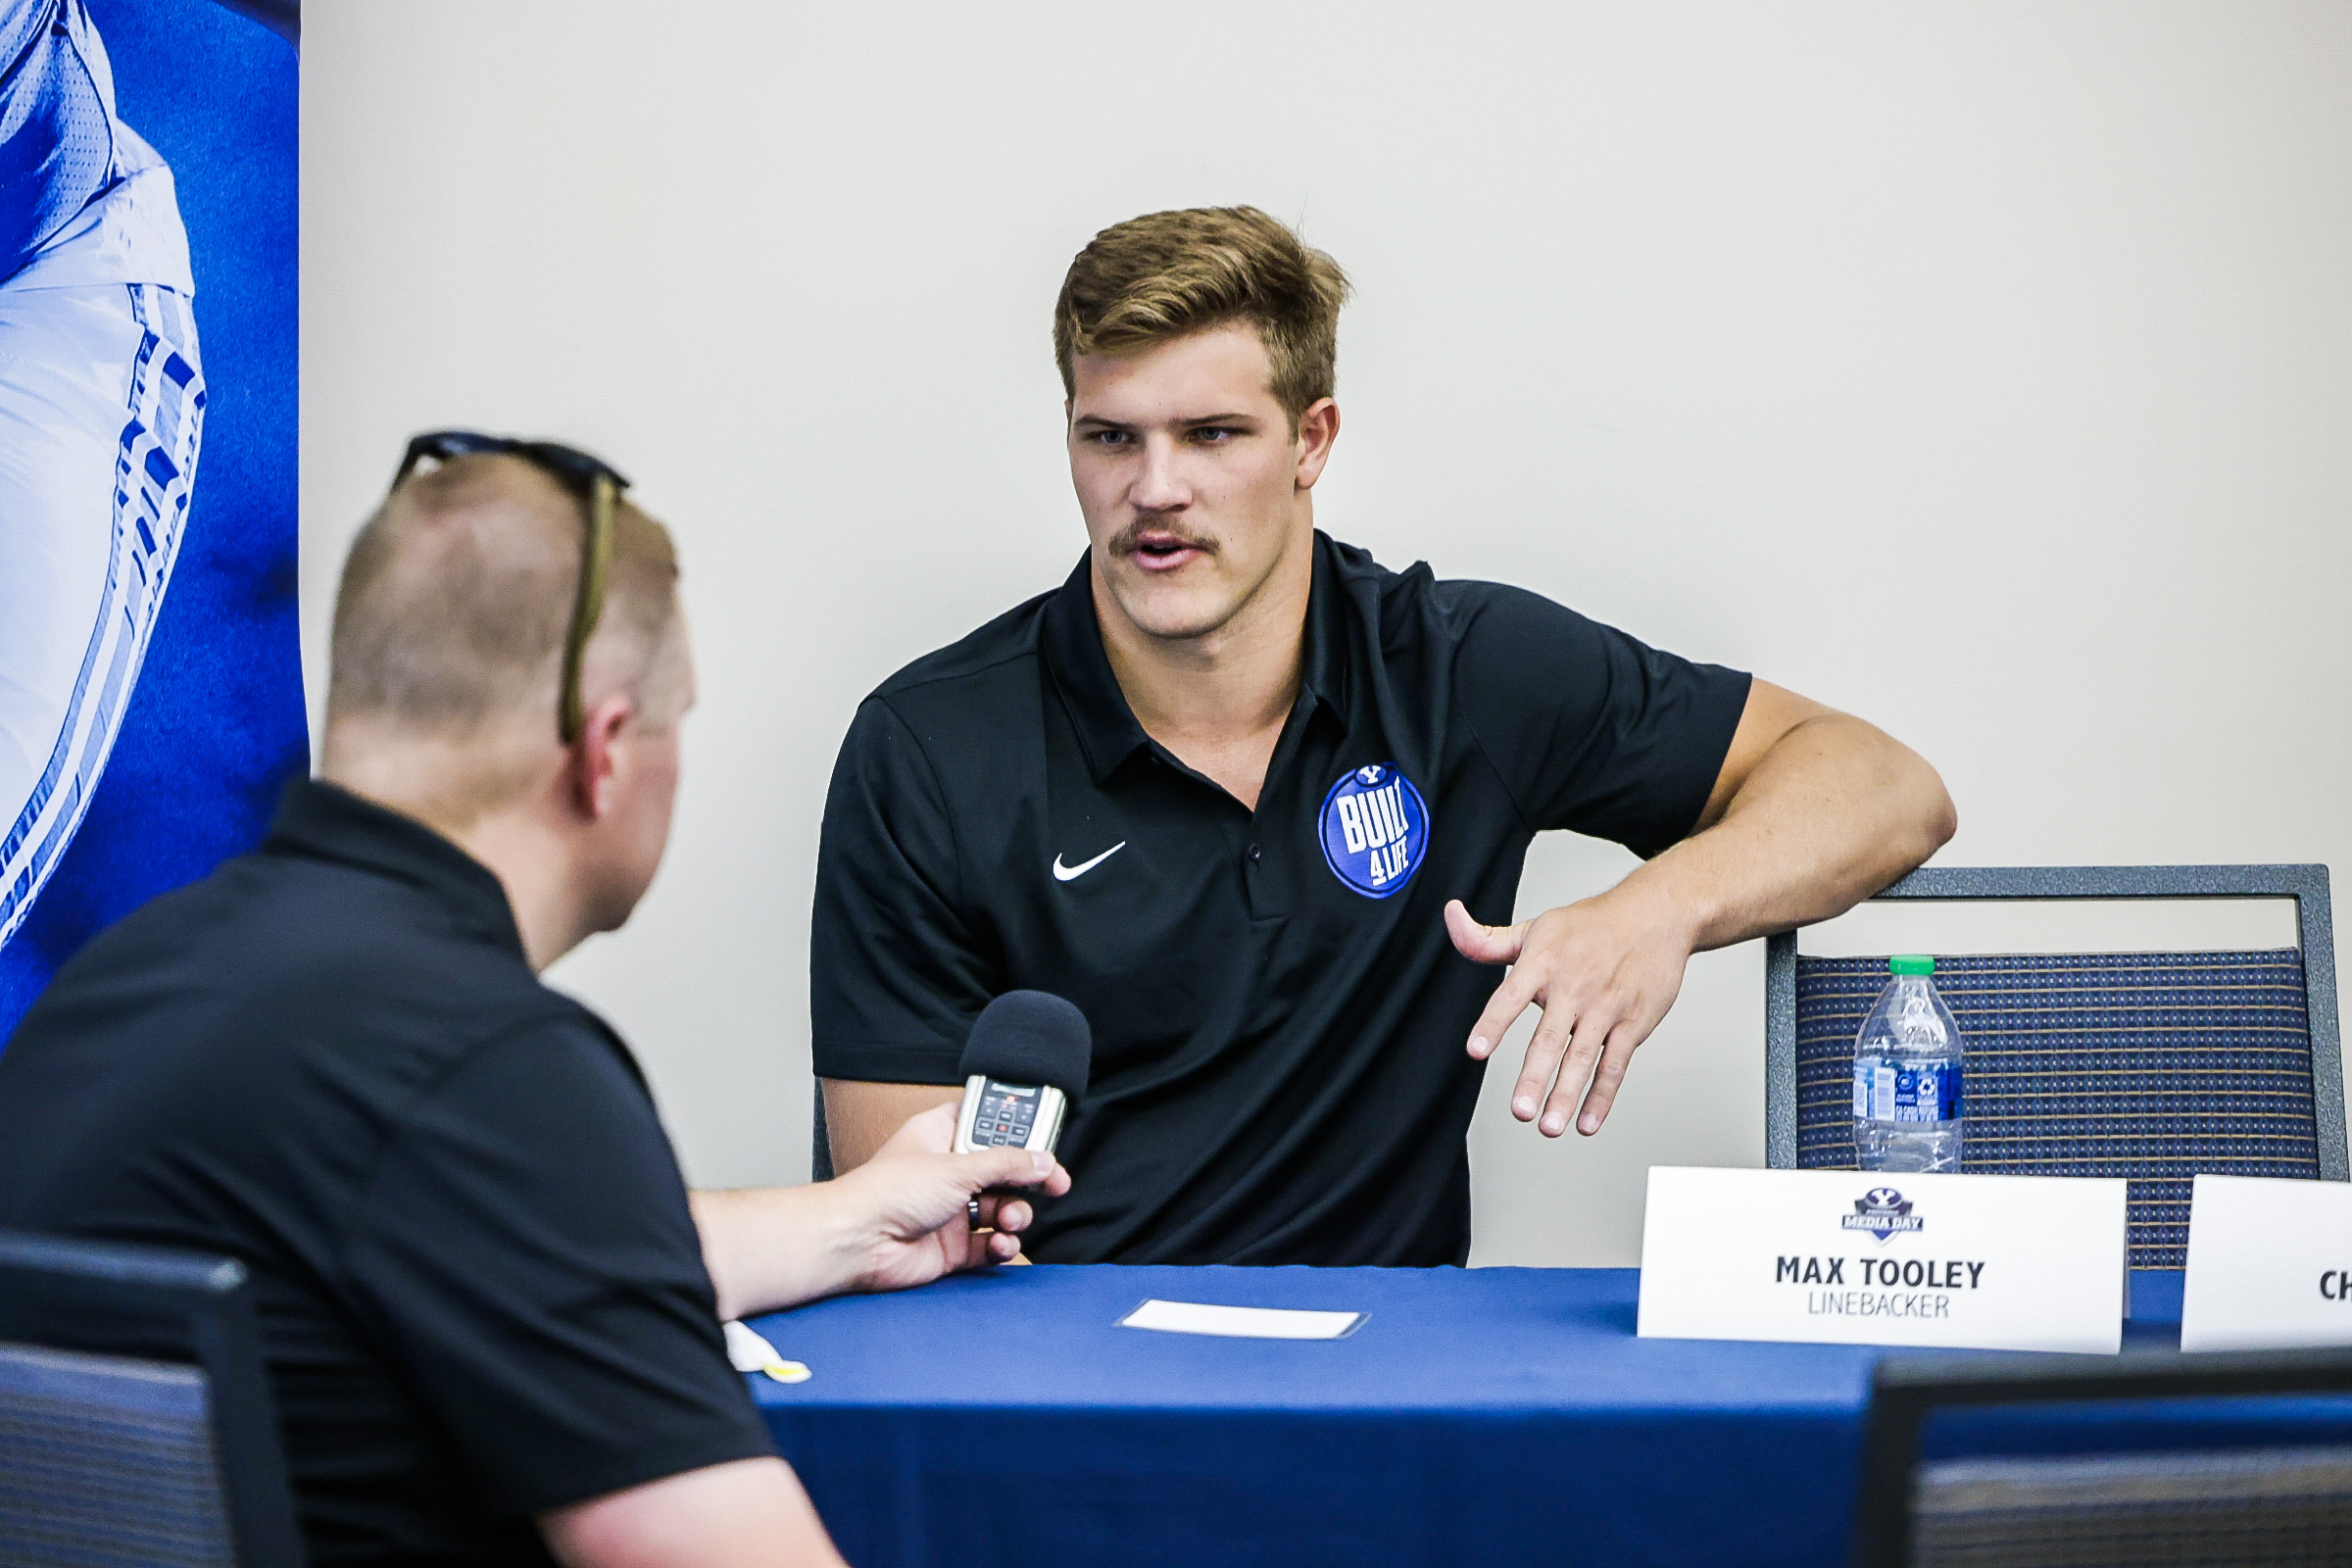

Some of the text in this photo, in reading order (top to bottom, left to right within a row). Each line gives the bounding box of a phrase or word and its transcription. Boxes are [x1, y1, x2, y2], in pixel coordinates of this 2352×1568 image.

[1359, 765, 1382, 784] Y
[1871, 1187, 1896, 1206] Y
[1843, 1215, 1922, 1230] MEDIA DAY
[1776, 1255, 1985, 1289] MAX TOOLEY
[1808, 1291, 1950, 1319] LINEBACKER
